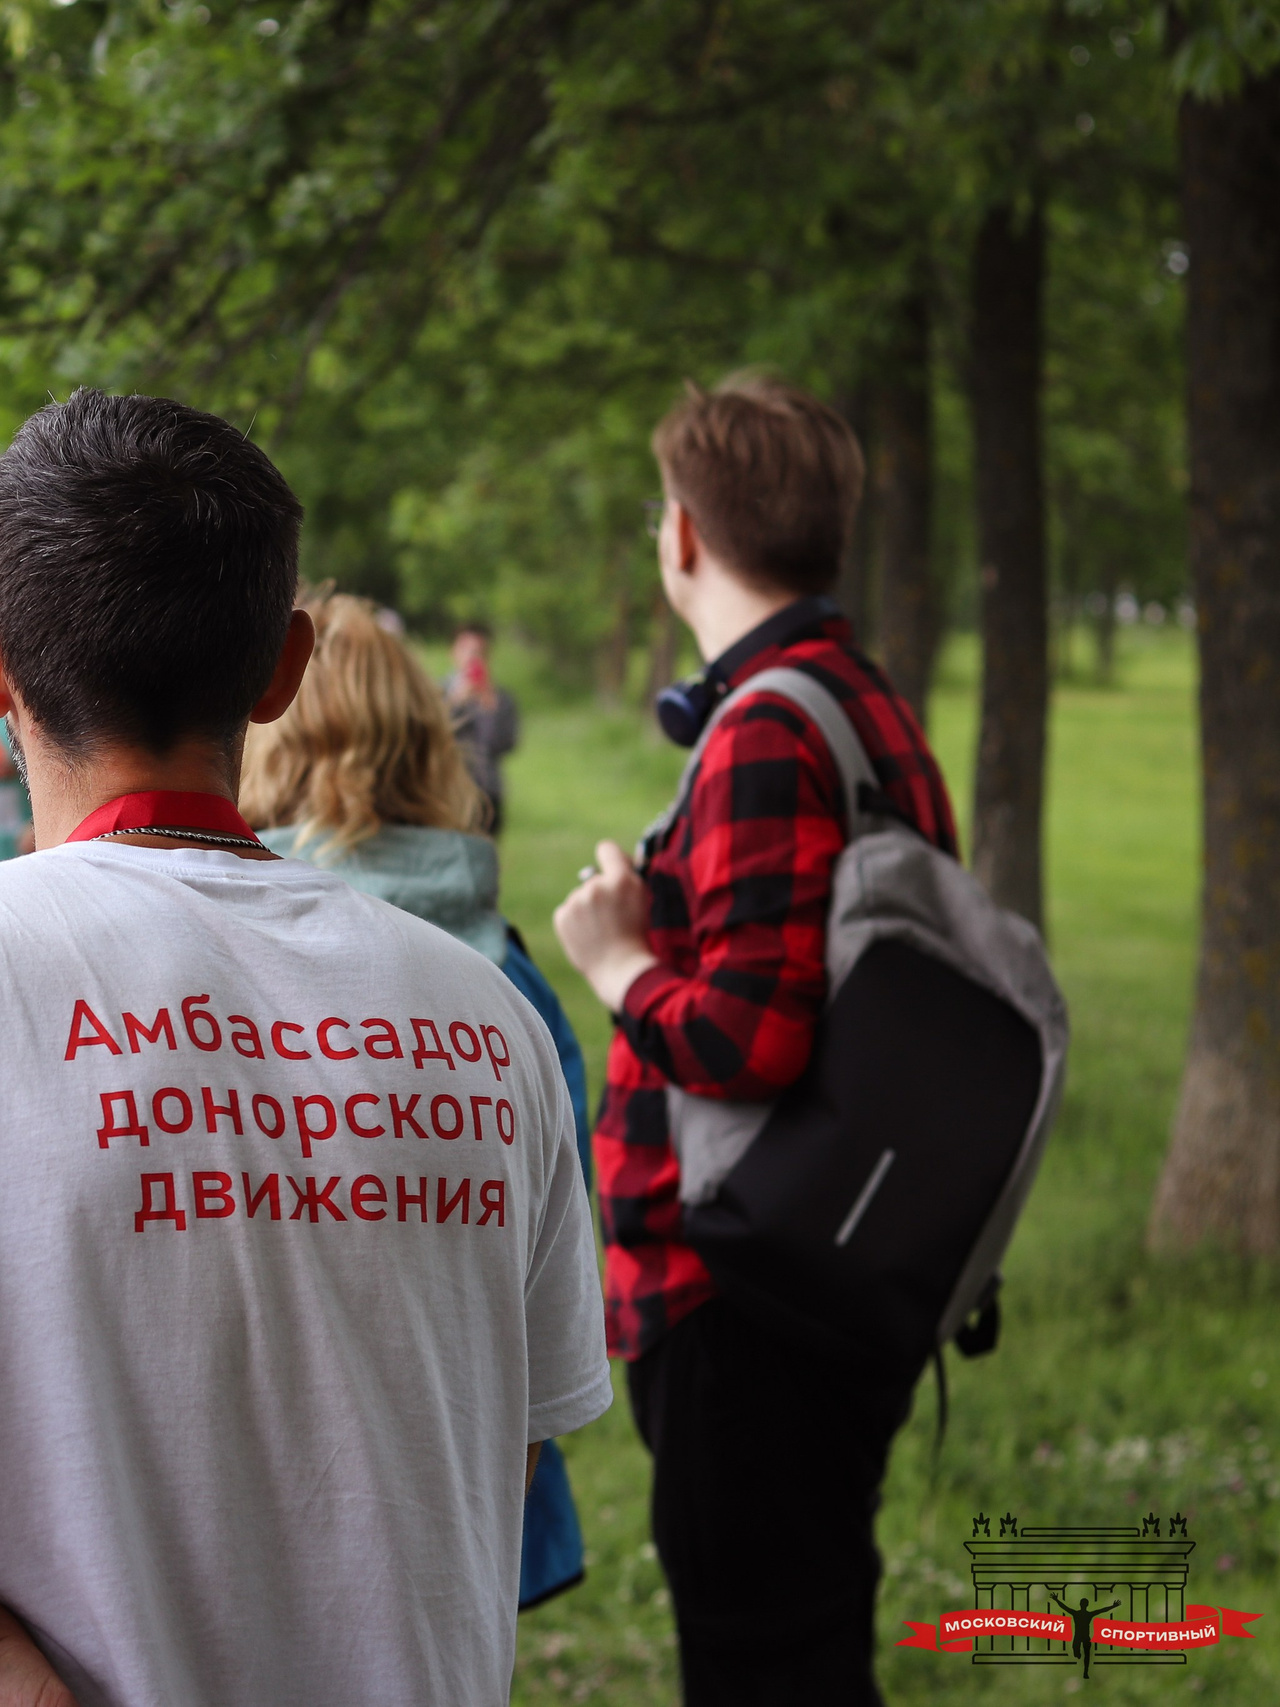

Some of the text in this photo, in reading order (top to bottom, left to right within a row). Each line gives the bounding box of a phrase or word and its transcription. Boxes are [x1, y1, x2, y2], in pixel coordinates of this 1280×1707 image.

[64, 993, 511, 1081] Амбассадор
[96, 1086, 515, 1158] донорского
[134, 1171, 506, 1233] движения
